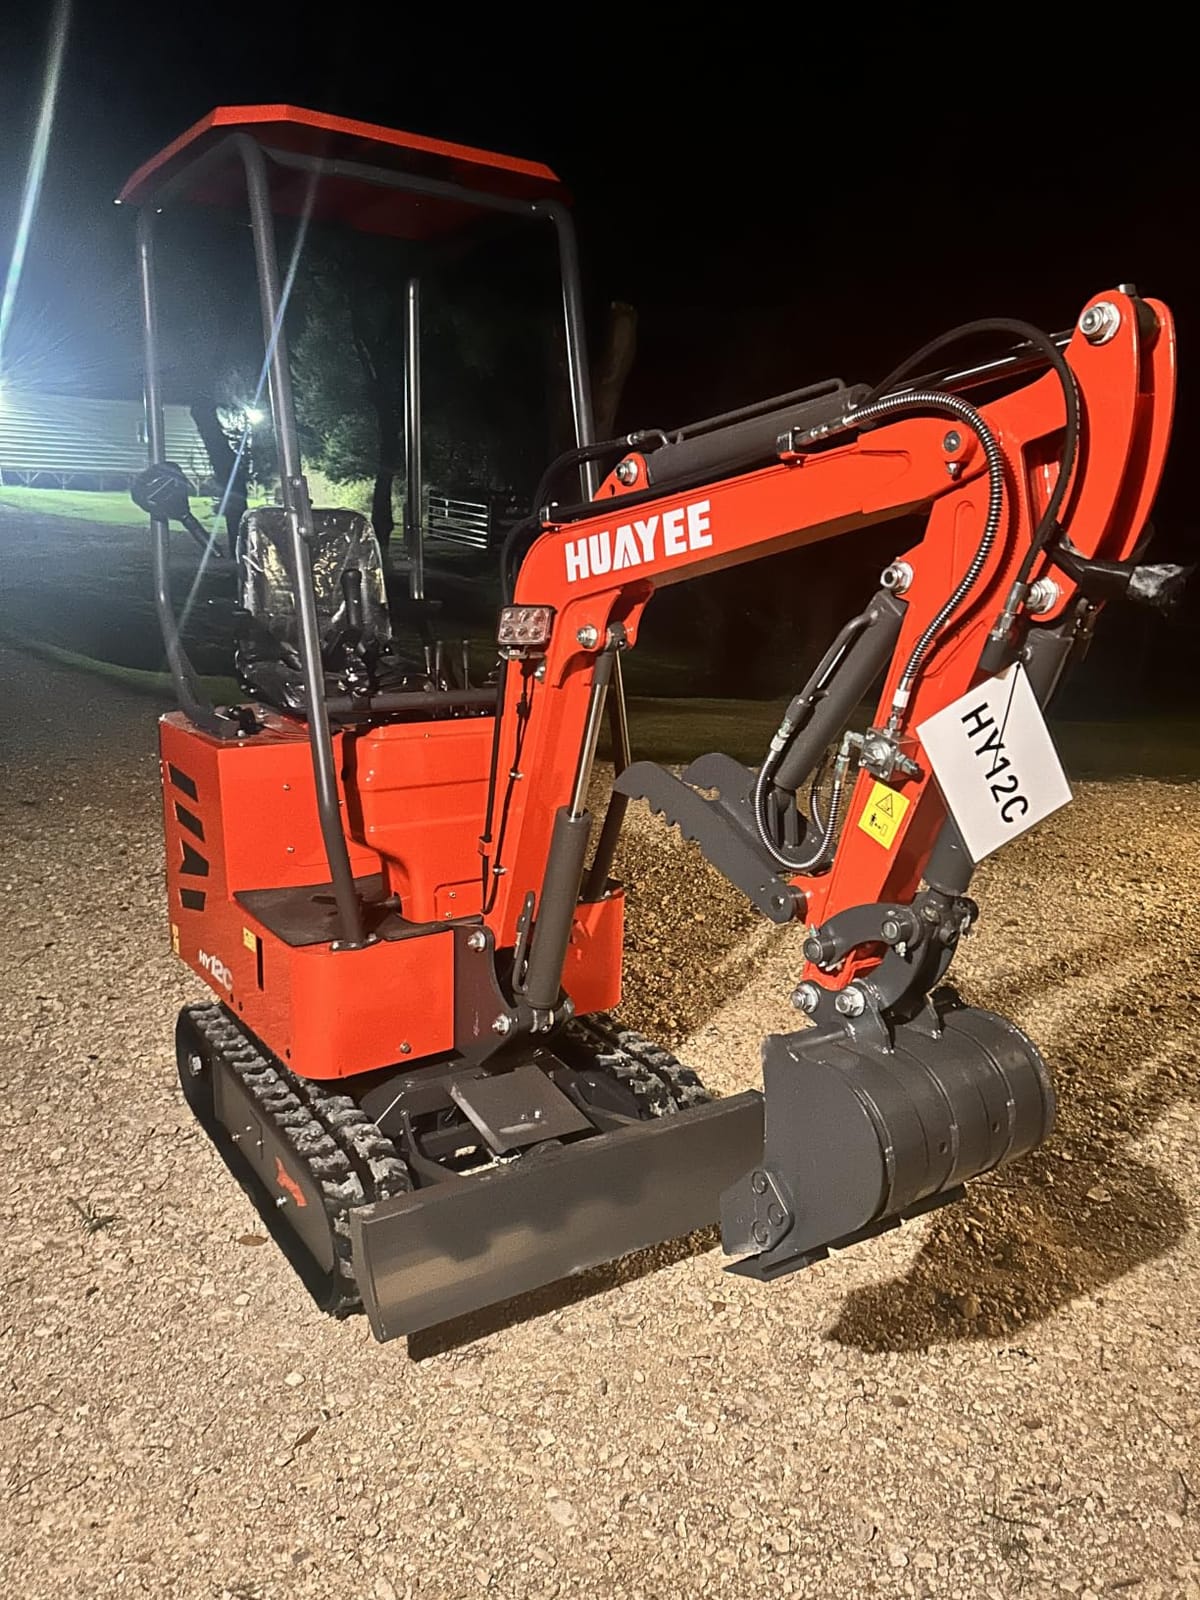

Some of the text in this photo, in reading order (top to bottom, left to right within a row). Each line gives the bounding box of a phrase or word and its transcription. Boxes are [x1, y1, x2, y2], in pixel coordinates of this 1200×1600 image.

[565, 500, 713, 583] HUAYEE
[961, 702, 1029, 824] HY12C
[199, 949, 233, 991] HY12C
